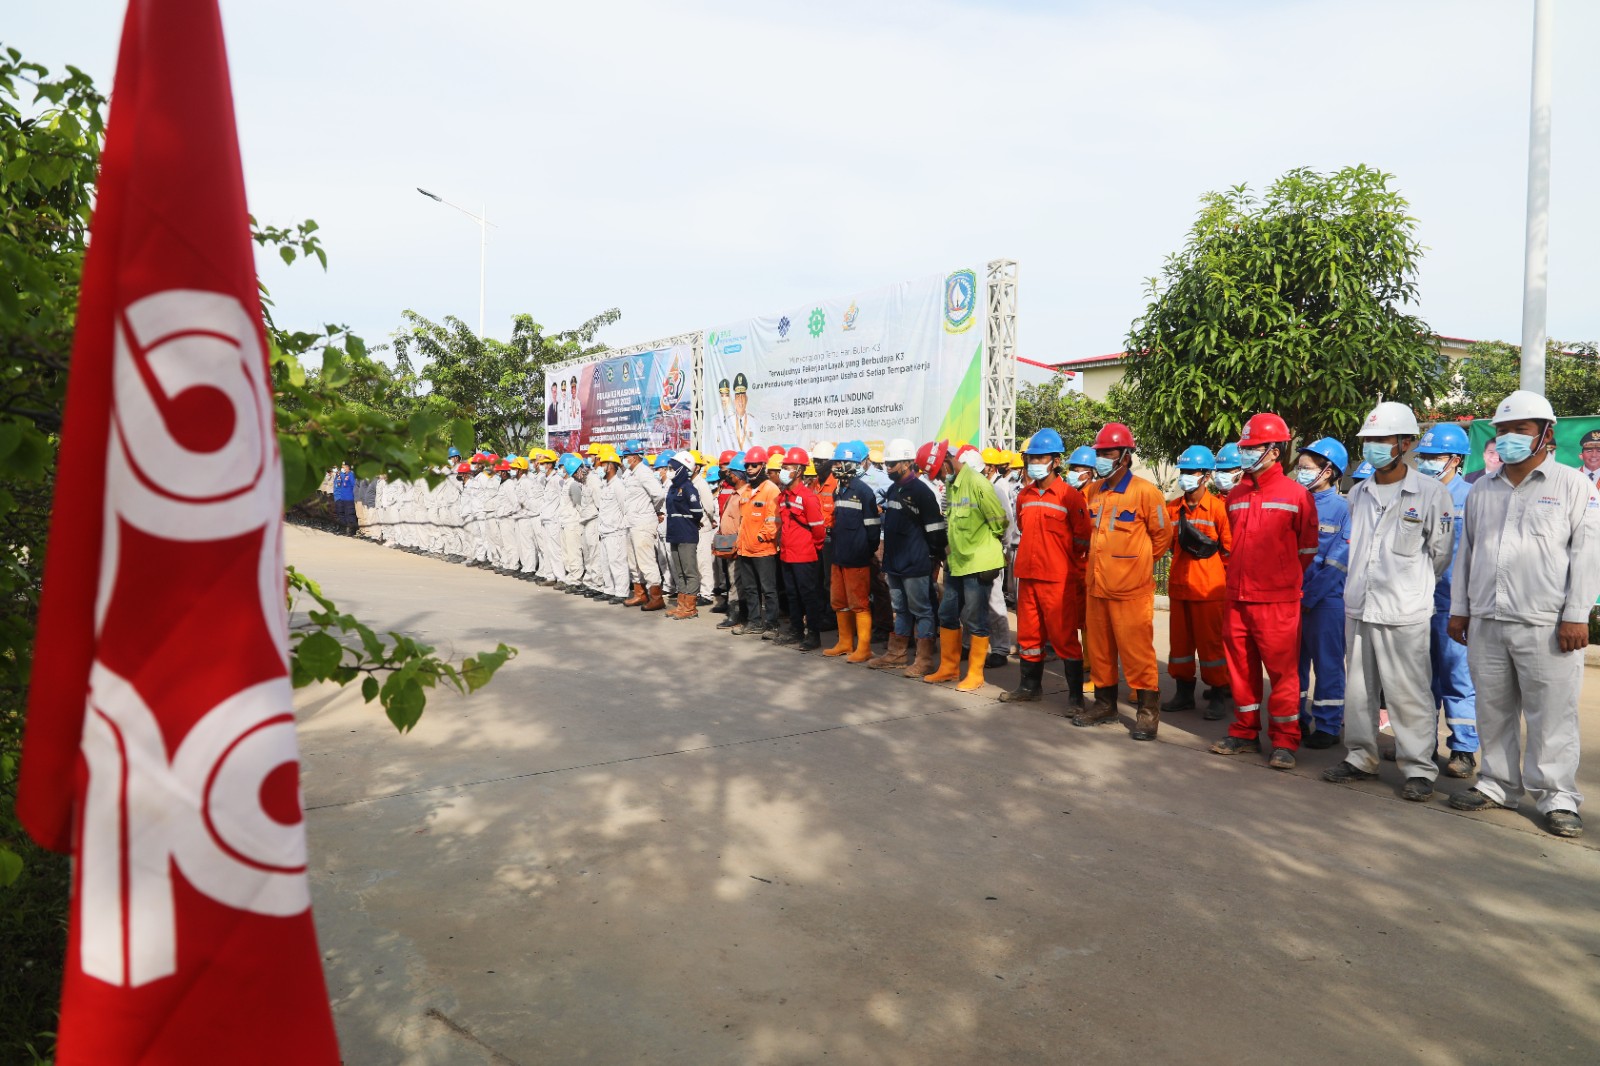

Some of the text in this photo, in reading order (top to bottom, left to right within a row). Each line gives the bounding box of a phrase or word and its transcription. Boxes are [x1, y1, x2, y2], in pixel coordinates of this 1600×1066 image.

[845, 359, 860, 369] yang
[861, 355, 894, 366] Berbudaya
[895, 352, 905, 361] K3
[840, 371, 857, 380] Usaha
[859, 369, 866, 377] di
[866, 367, 885, 377] Setiap
[887, 363, 913, 374] Tempat
[793, 391, 874, 406] BERSAMA KITA LINDUNGI
[793, 409, 813, 420] Pekerja
[827, 407, 849, 418] Proyek
[850, 406, 865, 415] Jasa
[866, 402, 905, 414] Konstruksi
[845, 417, 862, 428] BPJS
